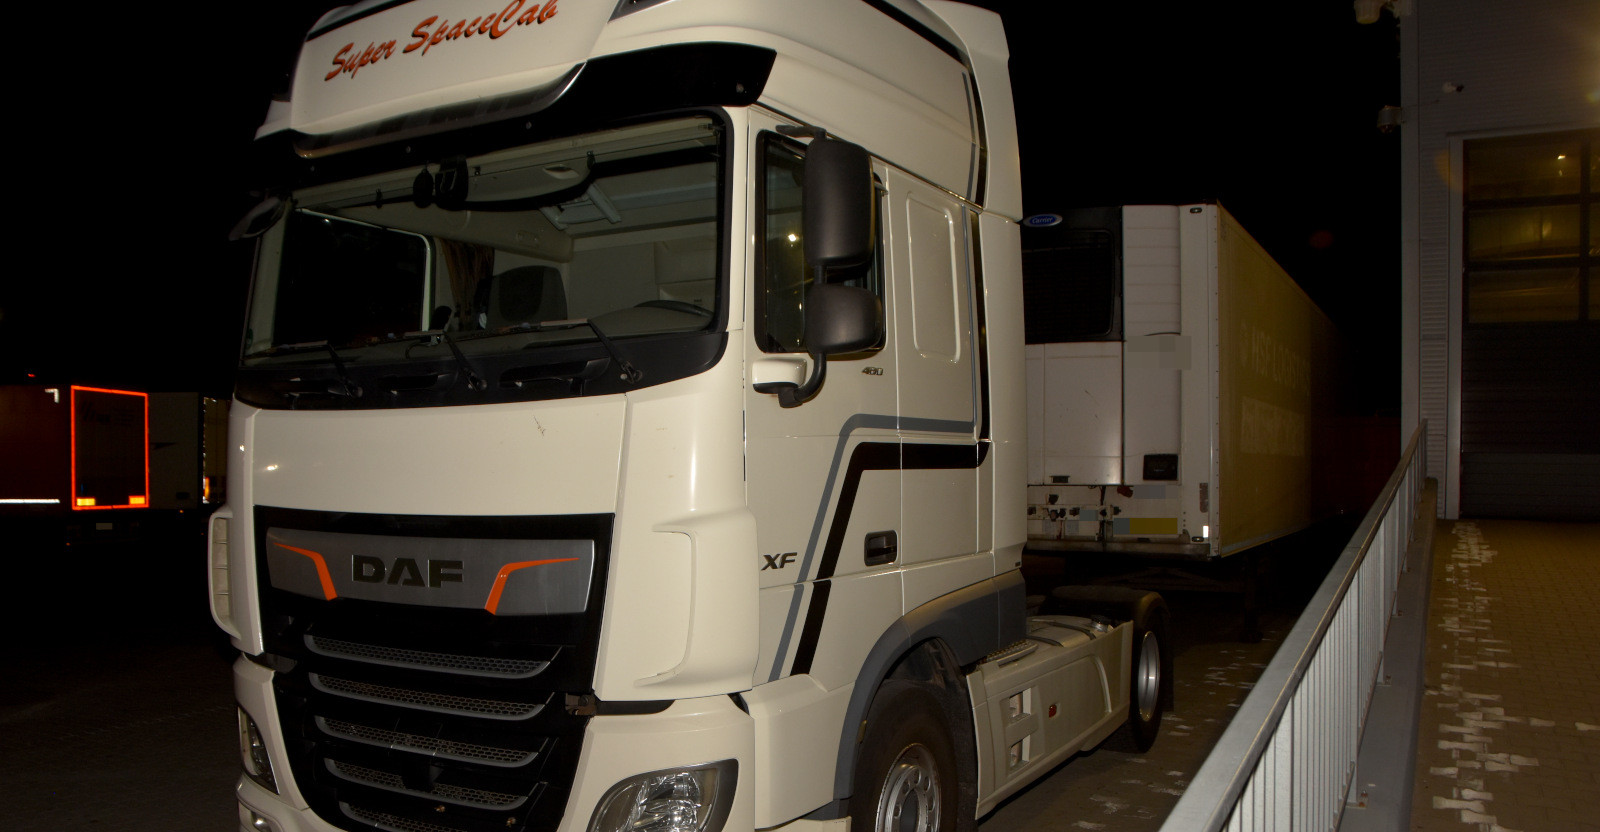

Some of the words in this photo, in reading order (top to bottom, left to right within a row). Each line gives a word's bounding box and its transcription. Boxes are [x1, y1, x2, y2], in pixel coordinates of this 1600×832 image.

[324, 39, 397, 82] Super
[402, 0, 559, 57] SpaceCab
[1031, 216, 1054, 225] Carrier
[351, 554, 464, 589] DAF
[761, 552, 798, 571] XF
